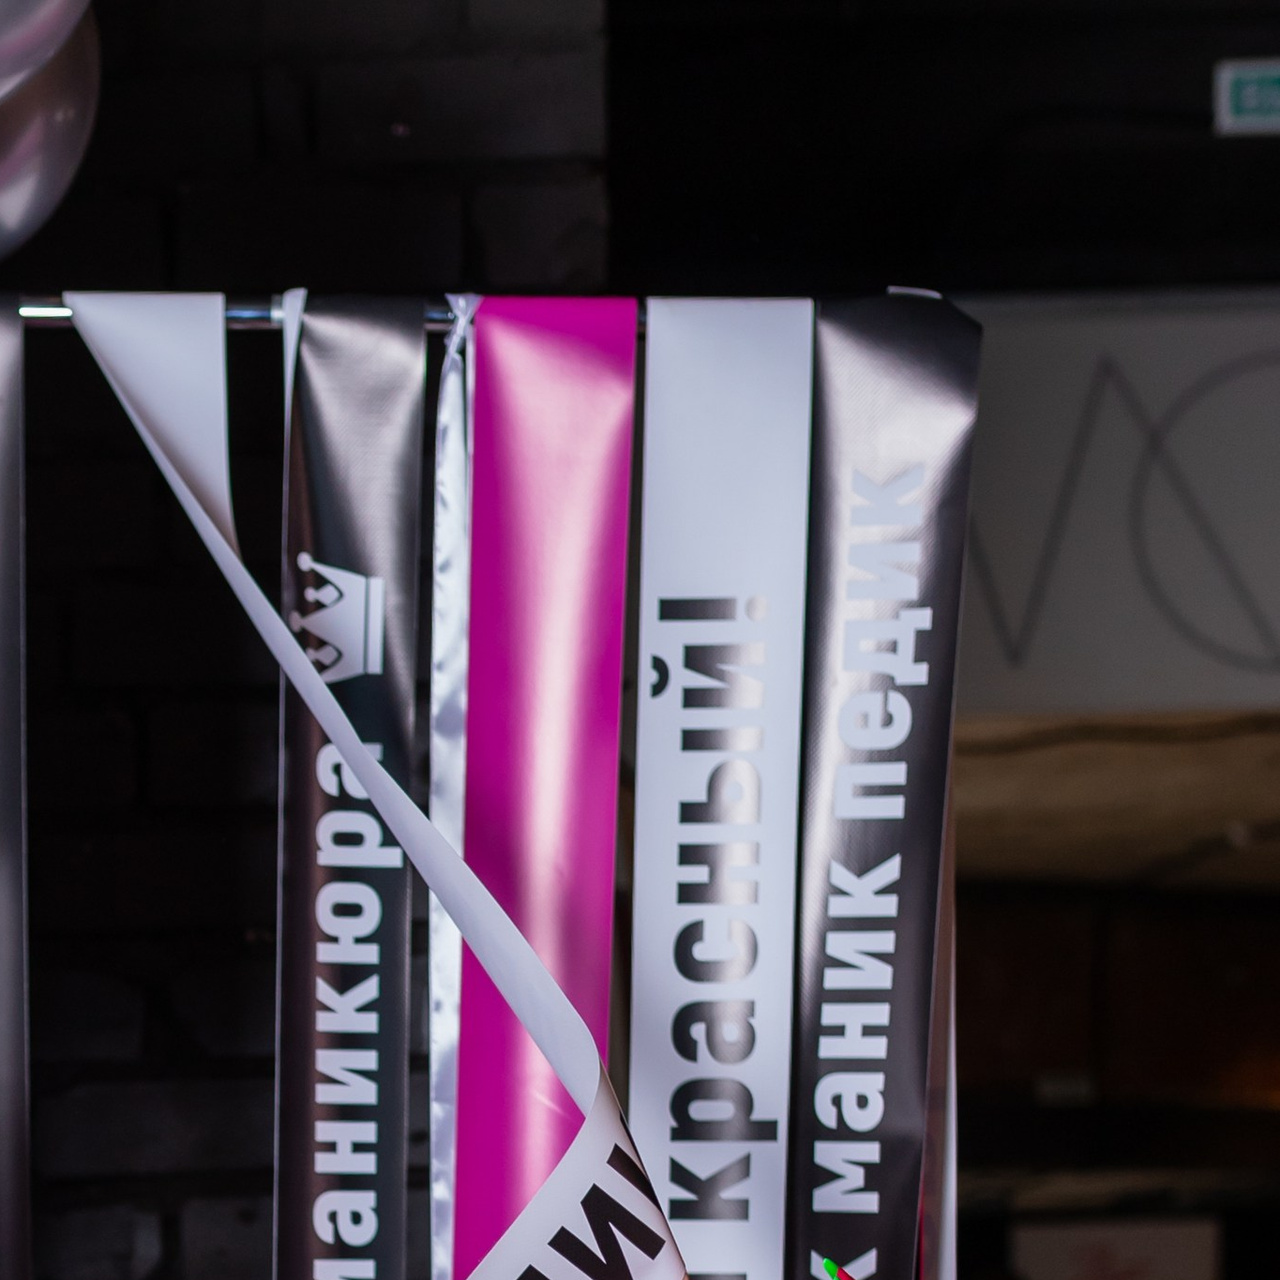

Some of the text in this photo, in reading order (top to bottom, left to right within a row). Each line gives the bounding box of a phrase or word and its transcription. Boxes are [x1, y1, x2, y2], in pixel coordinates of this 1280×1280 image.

[830, 462, 934, 820] педик
[650, 596, 779, 1222] красный!
[812, 853, 903, 1213] маник
